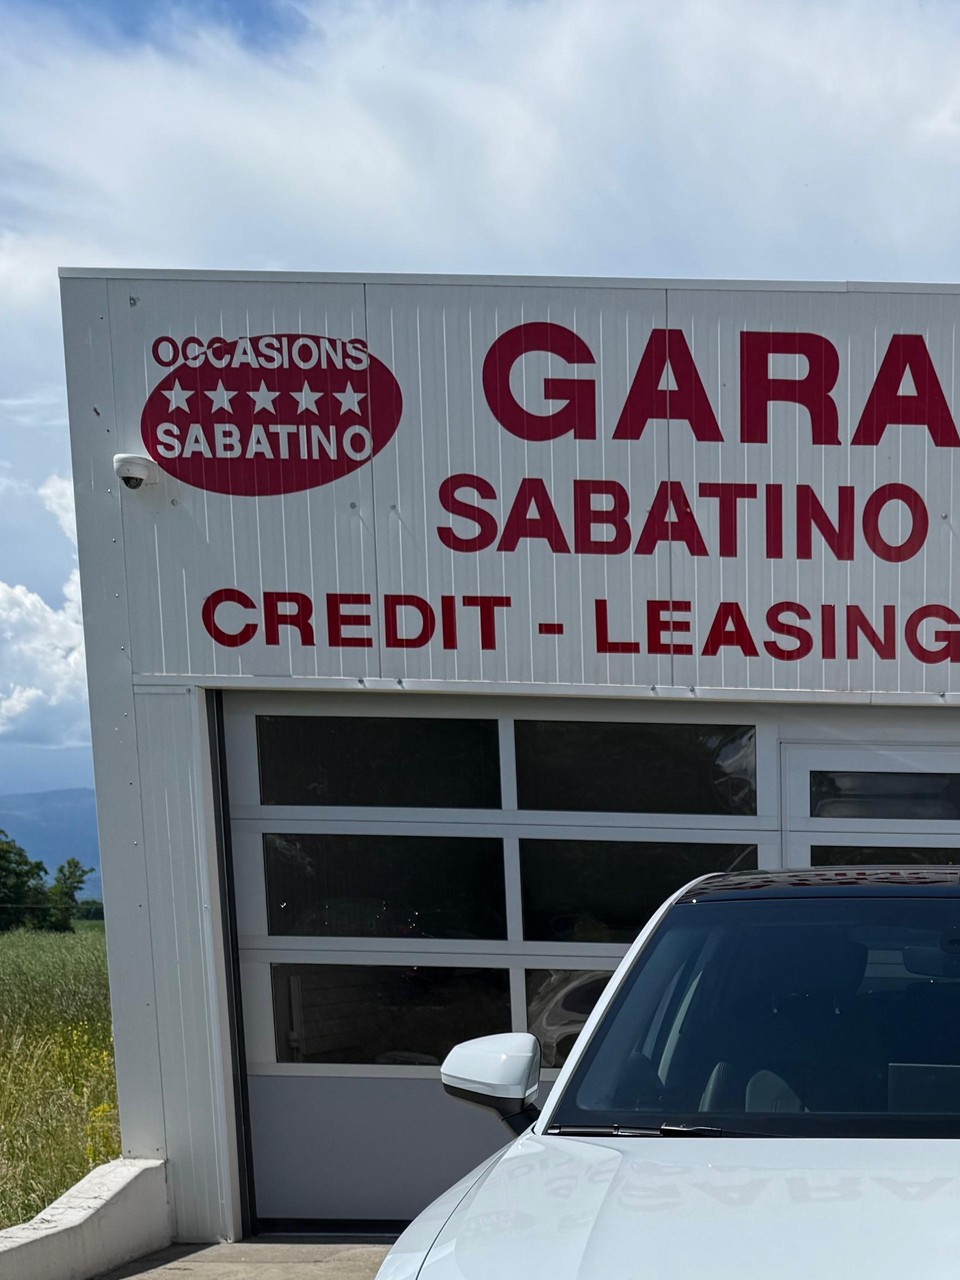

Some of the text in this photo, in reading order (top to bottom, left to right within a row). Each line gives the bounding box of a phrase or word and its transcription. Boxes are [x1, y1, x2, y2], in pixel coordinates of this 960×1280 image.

[152, 335, 371, 371] OCCASIONS
[156, 422, 374, 462] SABATINO
[437, 473, 930, 563] SABATINO
[202, 588, 511, 650] CREDIT
